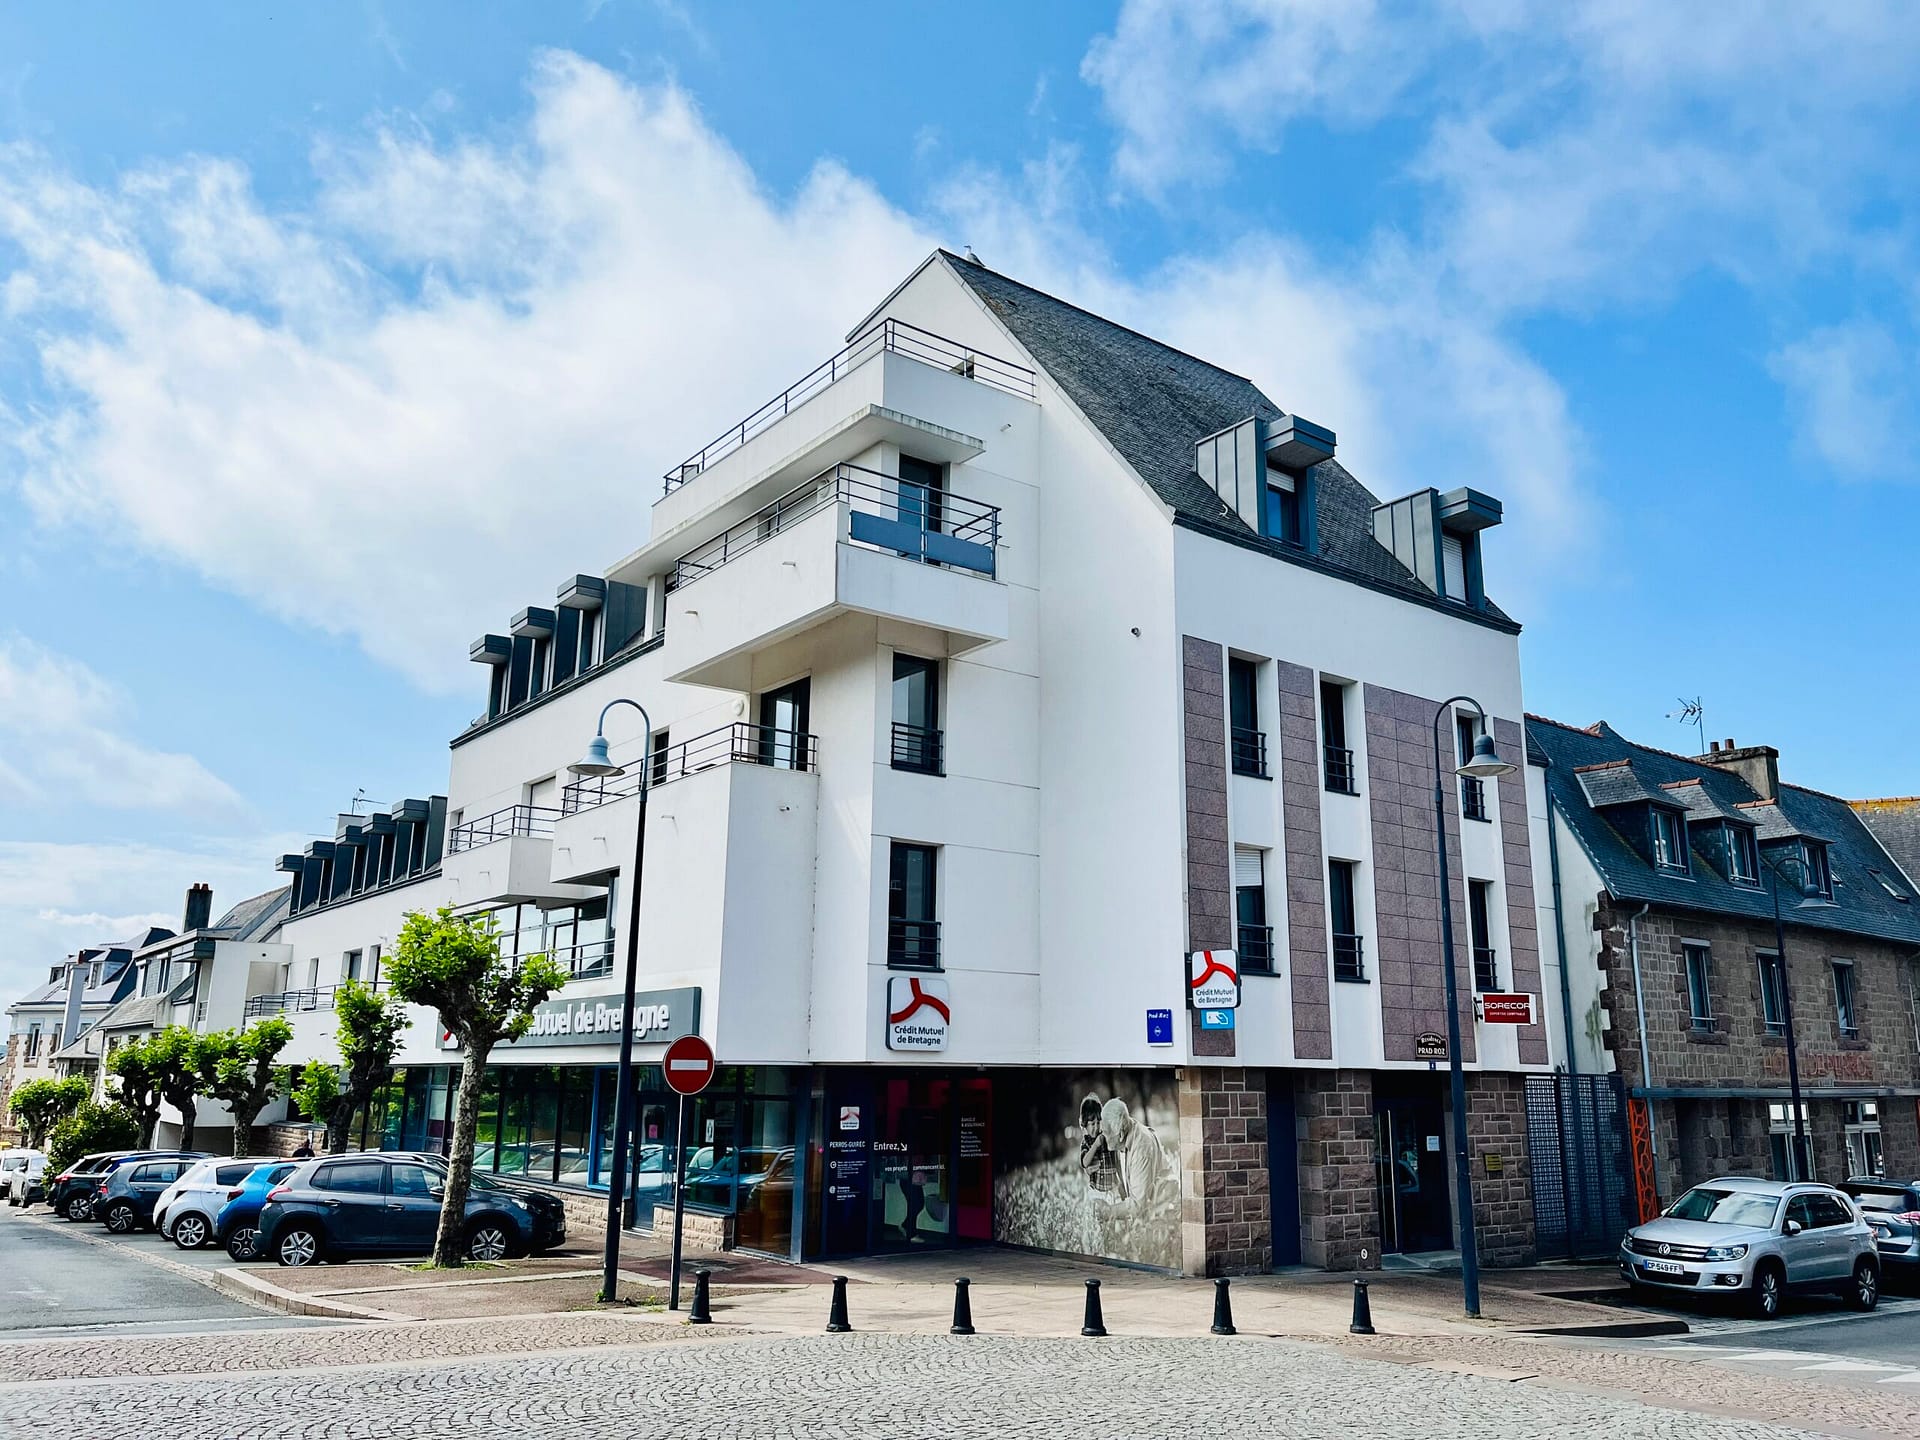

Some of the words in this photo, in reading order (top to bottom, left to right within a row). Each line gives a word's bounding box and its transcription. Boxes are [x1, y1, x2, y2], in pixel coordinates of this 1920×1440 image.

[1196, 988, 1214, 996] Crédit
[1214, 988, 1235, 996] Mutuel
[1198, 996, 1206, 1004] de
[1206, 997, 1233, 1005] Bretagne
[574, 1002, 594, 1033] de
[594, 1002, 670, 1039] Bretgne
[894, 1025, 917, 1034] Crédit
[918, 1026, 944, 1035] Mutuel
[897, 1035, 907, 1043] de
[908, 1036, 941, 1046] Bretagne
[1418, 1047, 1433, 1055] PRAD
[1434, 1047, 1446, 1055] ROZ
[873, 1141, 900, 1151] Entrez,
